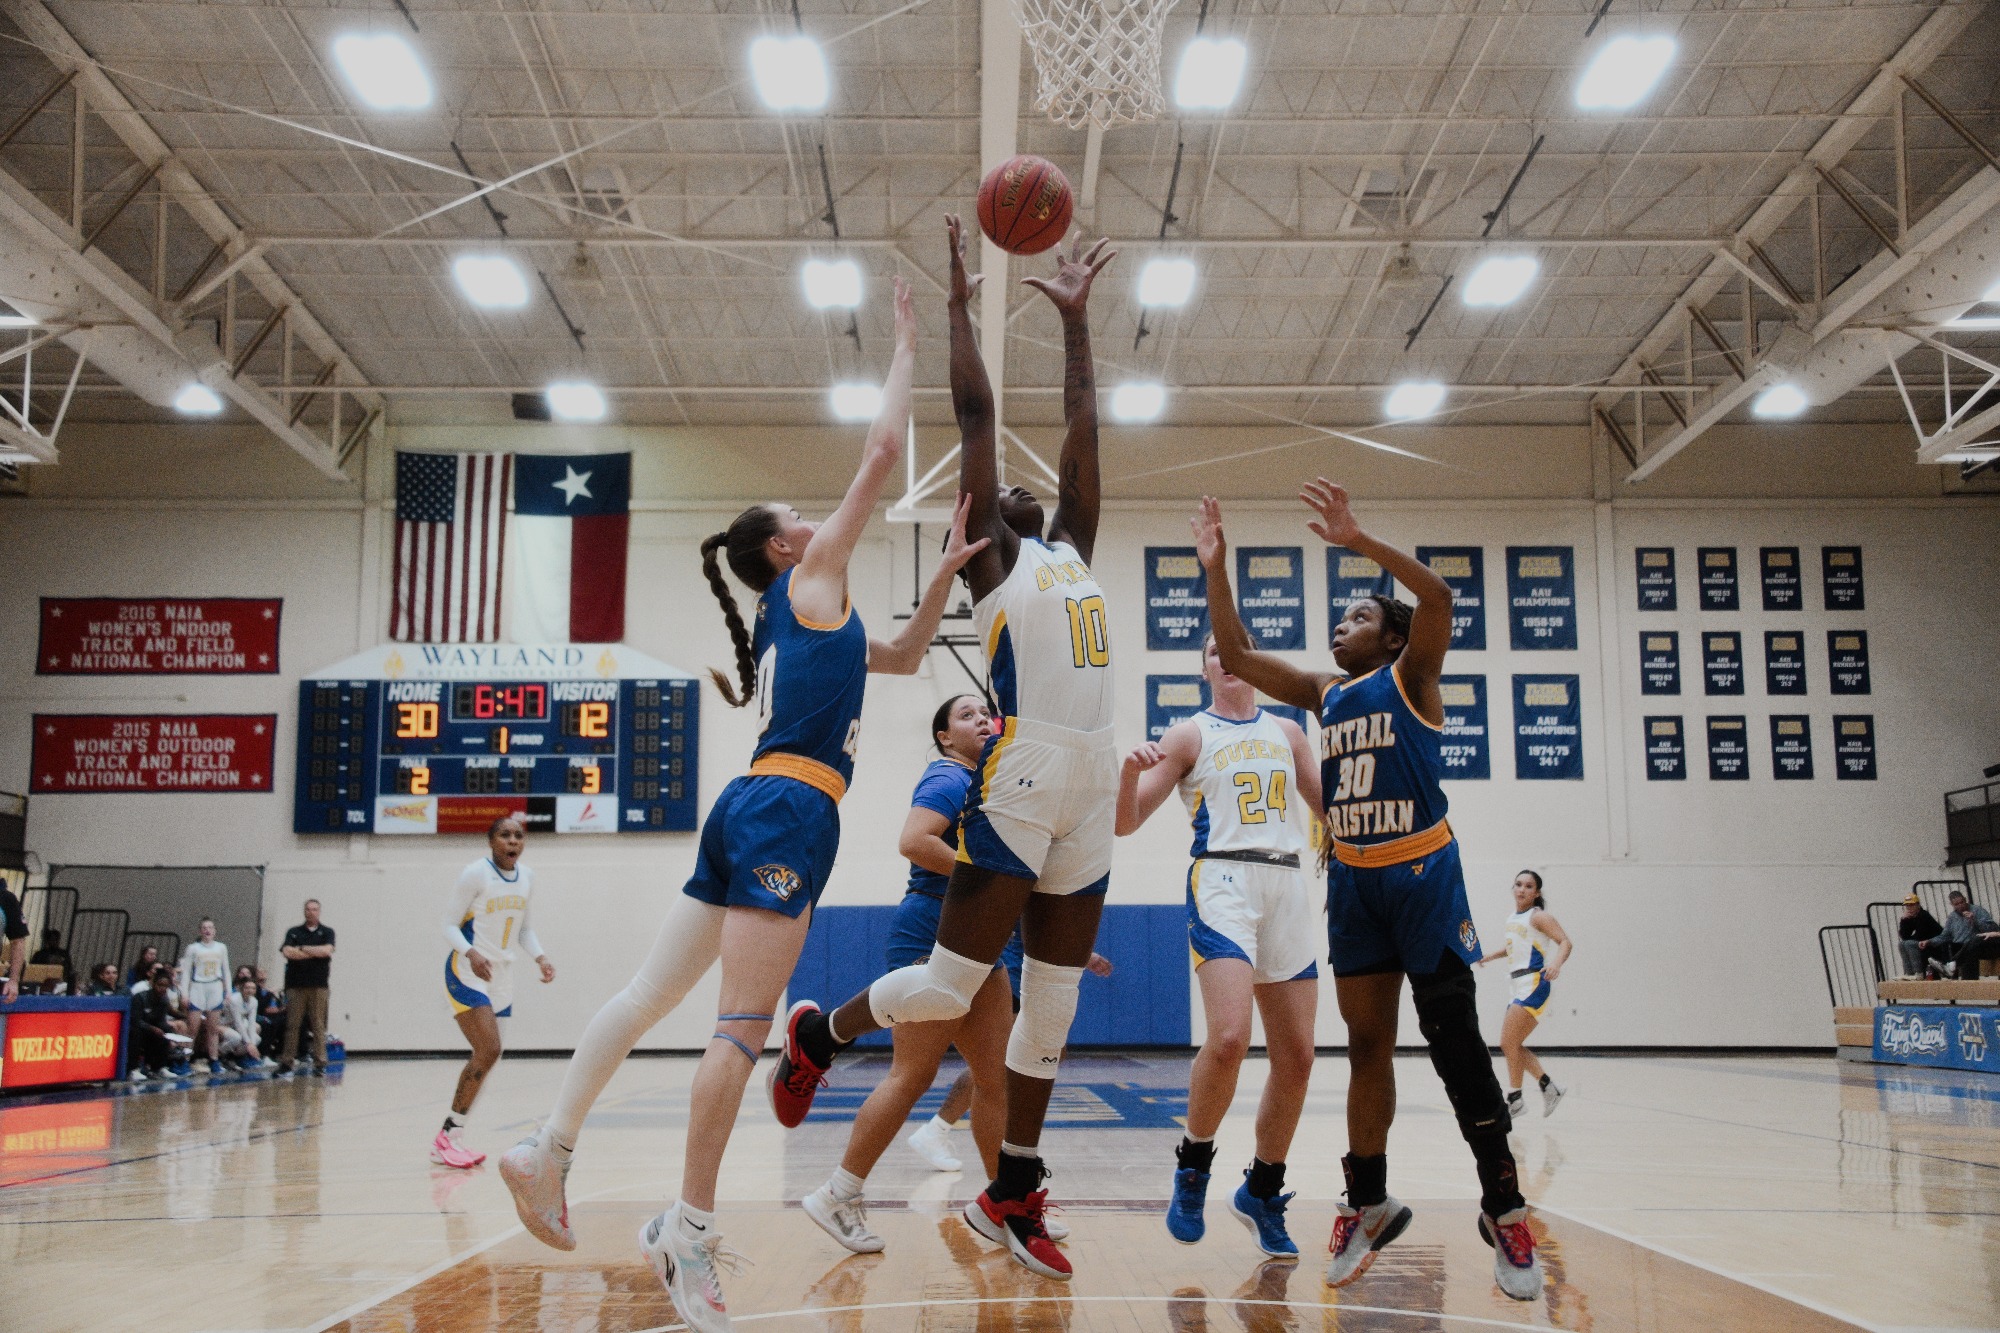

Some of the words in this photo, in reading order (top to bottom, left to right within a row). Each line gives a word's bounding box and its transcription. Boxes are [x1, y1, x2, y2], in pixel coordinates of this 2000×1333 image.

[1168, 588, 1189, 597] AAU
[1260, 588, 1280, 597] AAU
[1350, 588, 1370, 597] AAU
[1531, 588, 1552, 597] AAU
[1150, 598, 1207, 607] CHAMPIONS
[1242, 598, 1299, 607] CHAMPIONS
[1513, 597, 1570, 606] CHAMPIONS
[118, 606, 156, 620] 2016
[165, 606, 203, 620] NAIA
[88, 621, 162, 636] WOMEN'S
[171, 622, 232, 636] INDOOR
[1065, 595, 1109, 668] 10
[82, 638, 134, 652] TRACK
[144, 638, 177, 652] AND
[186, 638, 235, 652] FIELD
[70, 654, 153, 669] NATIONAL
[162, 654, 246, 668] CHAMPION
[422, 646, 583, 666] WAYLAND
[388, 684, 442, 702] HOME
[552, 684, 617, 701] VISITOR
[475, 685, 545, 718] 6:47
[396, 703, 438, 738] 30
[578, 703, 608, 738] 12
[1536, 716, 1558, 725] AAU
[113, 722, 151, 737] 2015
[160, 722, 198, 736] NAIA
[1321, 712, 1395, 762] ENTRAL
[1441, 726, 1484, 735] AMPIONS
[1519, 726, 1577, 735] CHAMPIONS
[73, 739, 148, 753] WOMEN'S
[158, 738, 236, 752] OUTDOOR
[499, 726, 508, 754] 1
[510, 734, 545, 746] PERIOD
[1214, 739, 1293, 771] QUEENS
[1440, 746, 1476, 756] 973-74
[75, 756, 128, 770] TRACK
[140, 756, 172, 769] AND
[181, 754, 230, 769] FIELD
[65, 771, 147, 786] NATIONAL
[157, 771, 240, 786] CHAMPION
[410, 767, 430, 795] 2
[582, 767, 600, 794] 3
[1333, 753, 1376, 801] 30
[1233, 770, 1286, 824] 24
[1327, 800, 1414, 838] RISTIAN
[502, 917, 513, 949] 1
[12, 1036, 65, 1062] WELLS
[66, 1034, 114, 1059] FARGO
